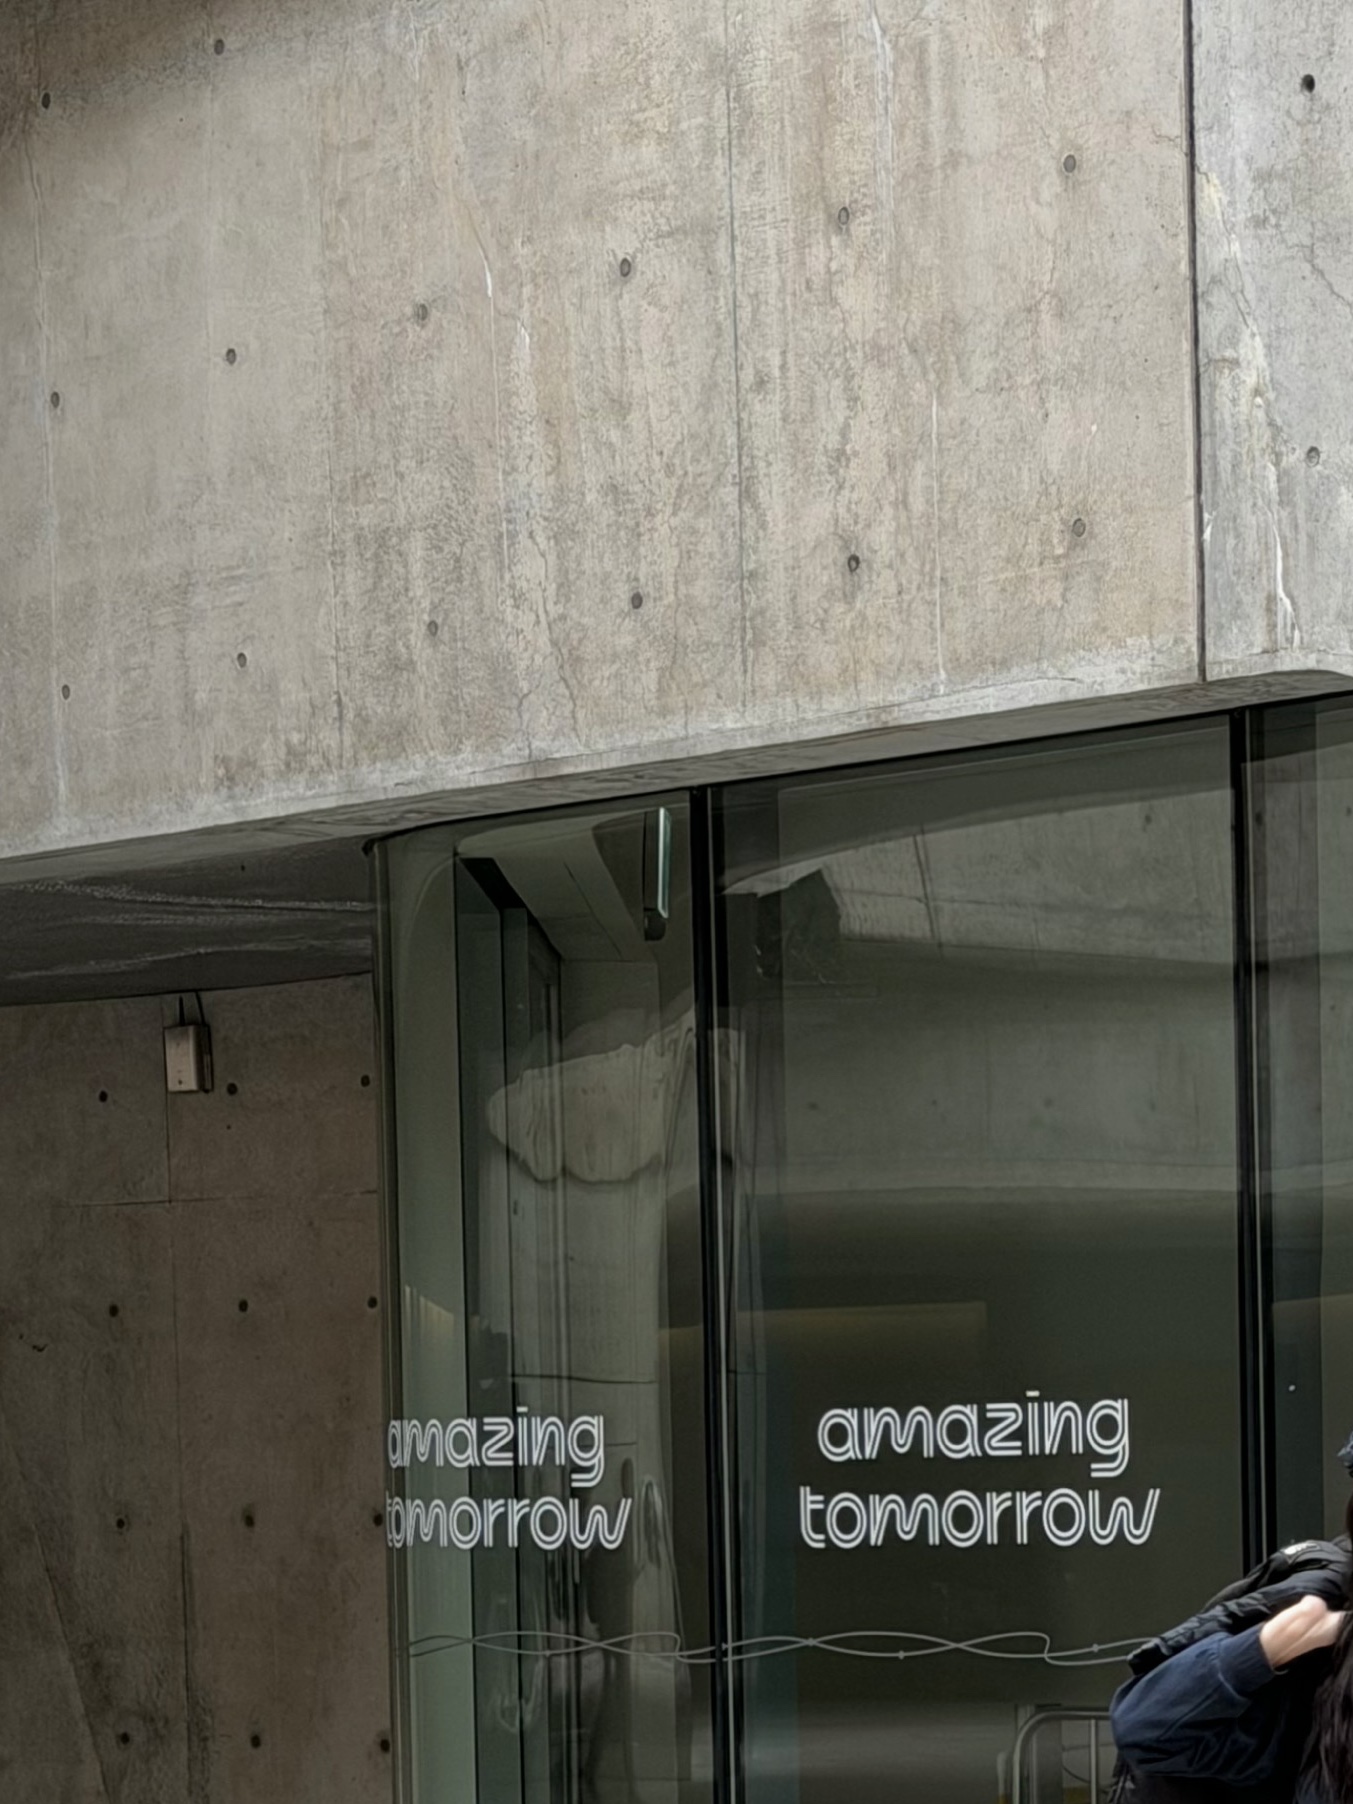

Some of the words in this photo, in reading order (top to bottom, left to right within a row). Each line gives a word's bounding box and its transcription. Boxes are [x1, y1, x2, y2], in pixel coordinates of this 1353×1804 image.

[387, 1406, 604, 1488] amazing
[817, 1390, 1129, 1478] amazing
[799, 1485, 1161, 1549] tomorrow
